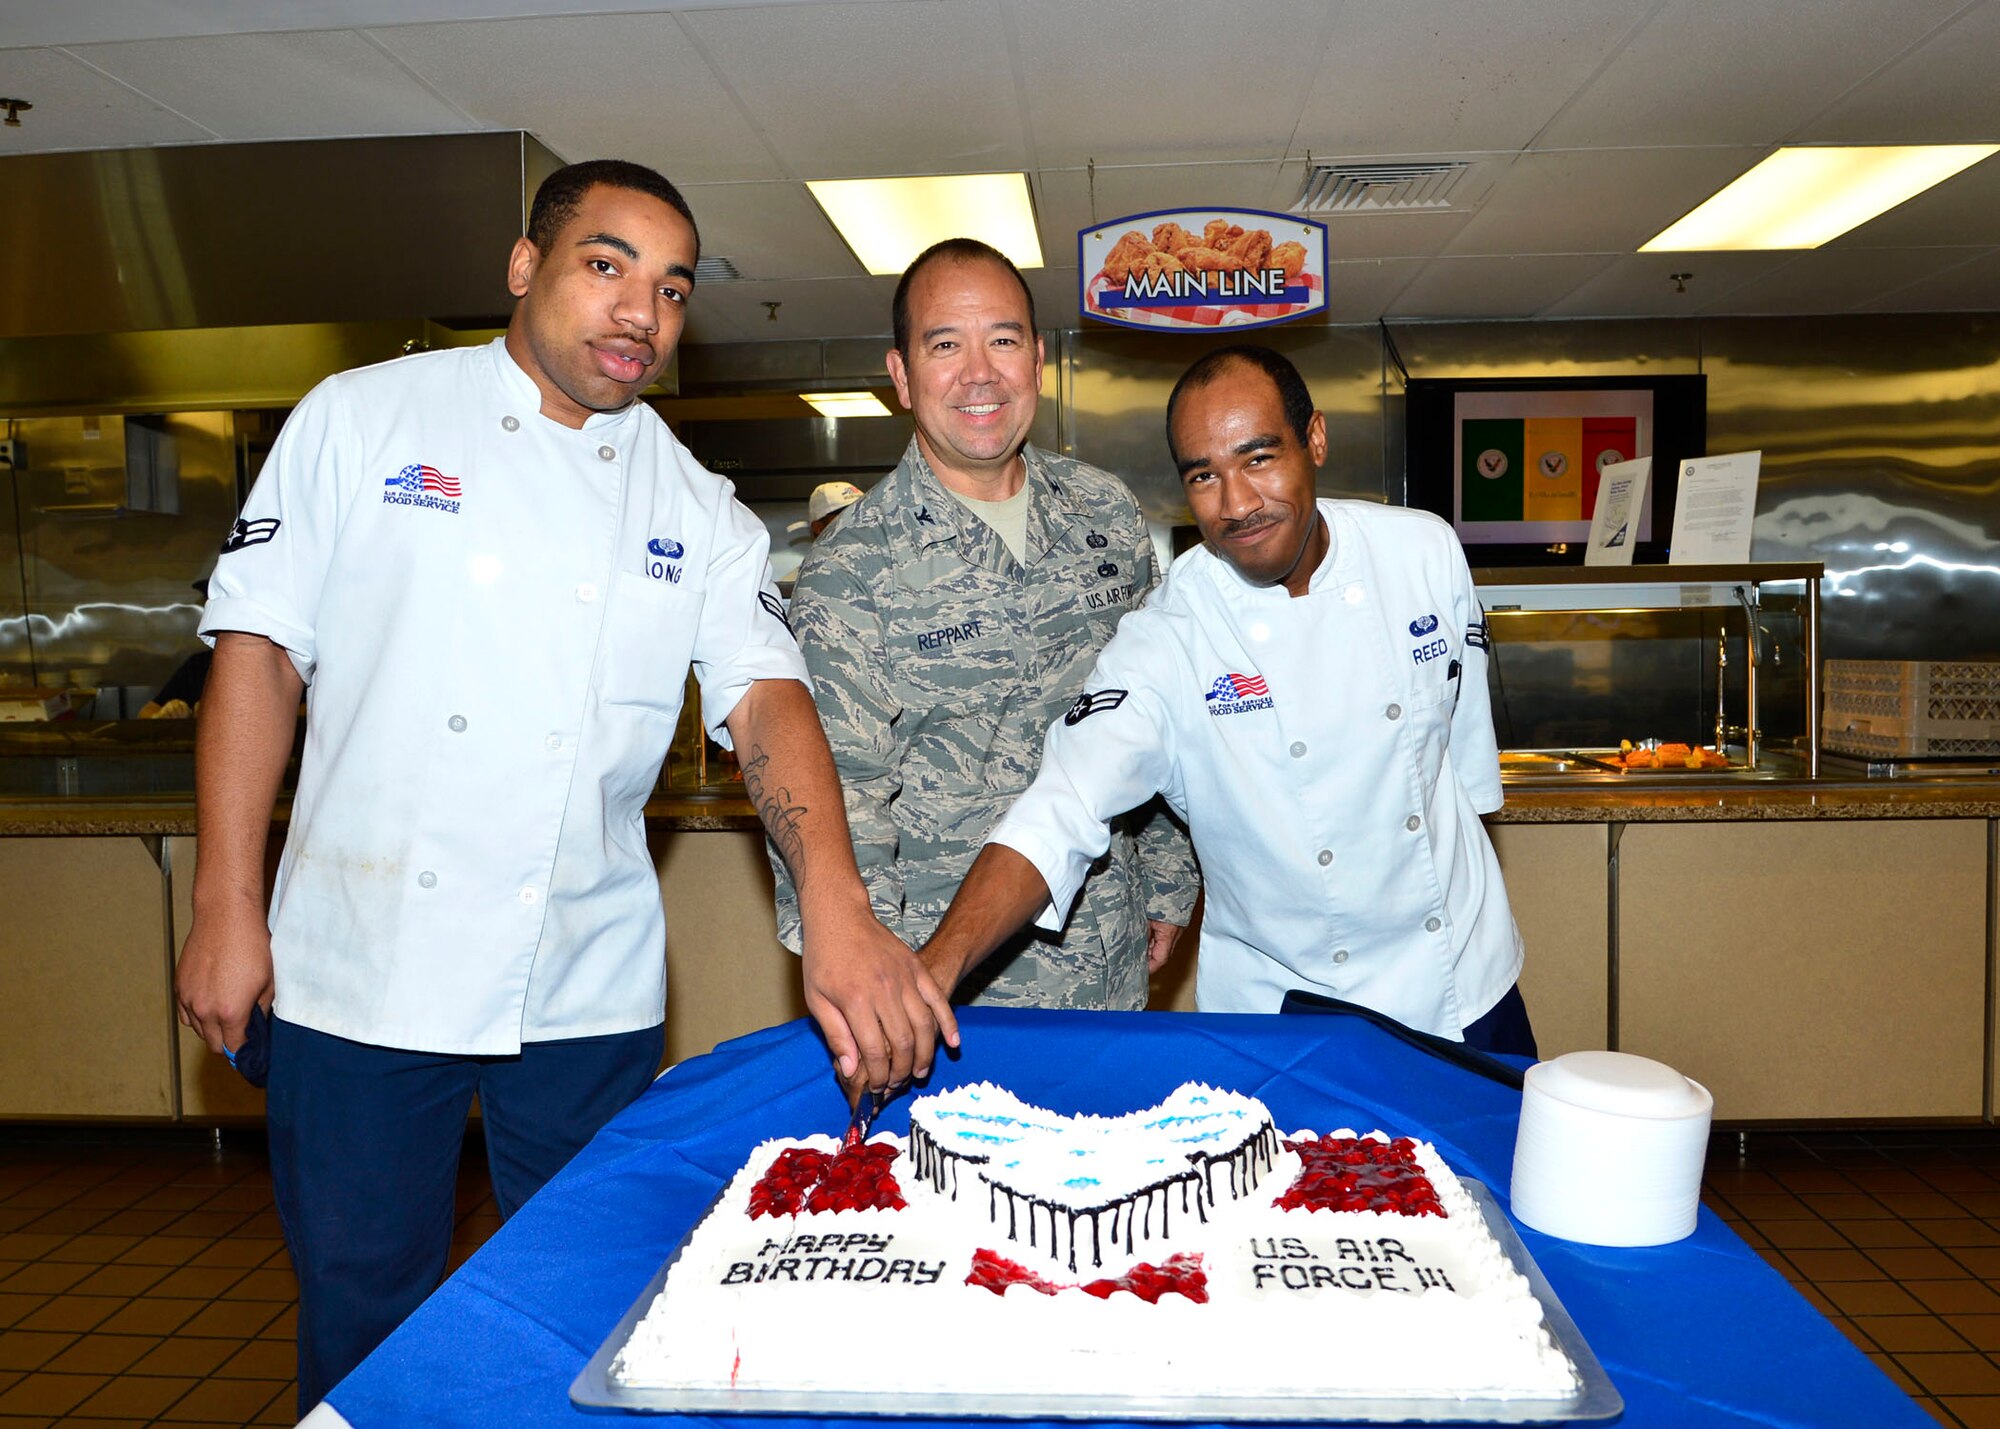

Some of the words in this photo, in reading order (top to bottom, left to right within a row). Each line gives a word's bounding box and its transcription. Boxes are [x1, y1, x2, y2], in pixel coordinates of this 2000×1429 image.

[1124, 268, 1208, 298] MAIN
[1218, 268, 1286, 297] LINE
[383, 495, 412, 506] FOOD
[412, 498, 460, 514] SERVICE
[1085, 592, 1106, 610] U.S.
[1106, 587, 1122, 606] AIR
[917, 620, 983, 652] REPPART
[1412, 638, 1448, 665] REED
[1209, 708, 1232, 716] FOOD
[1233, 703, 1274, 714] SERVICE
[757, 1233, 895, 1257] HAPPY
[1249, 1237, 1319, 1260] U.S.
[1335, 1238, 1415, 1264] AIR
[720, 1257, 947, 1286] BIRTHDAY
